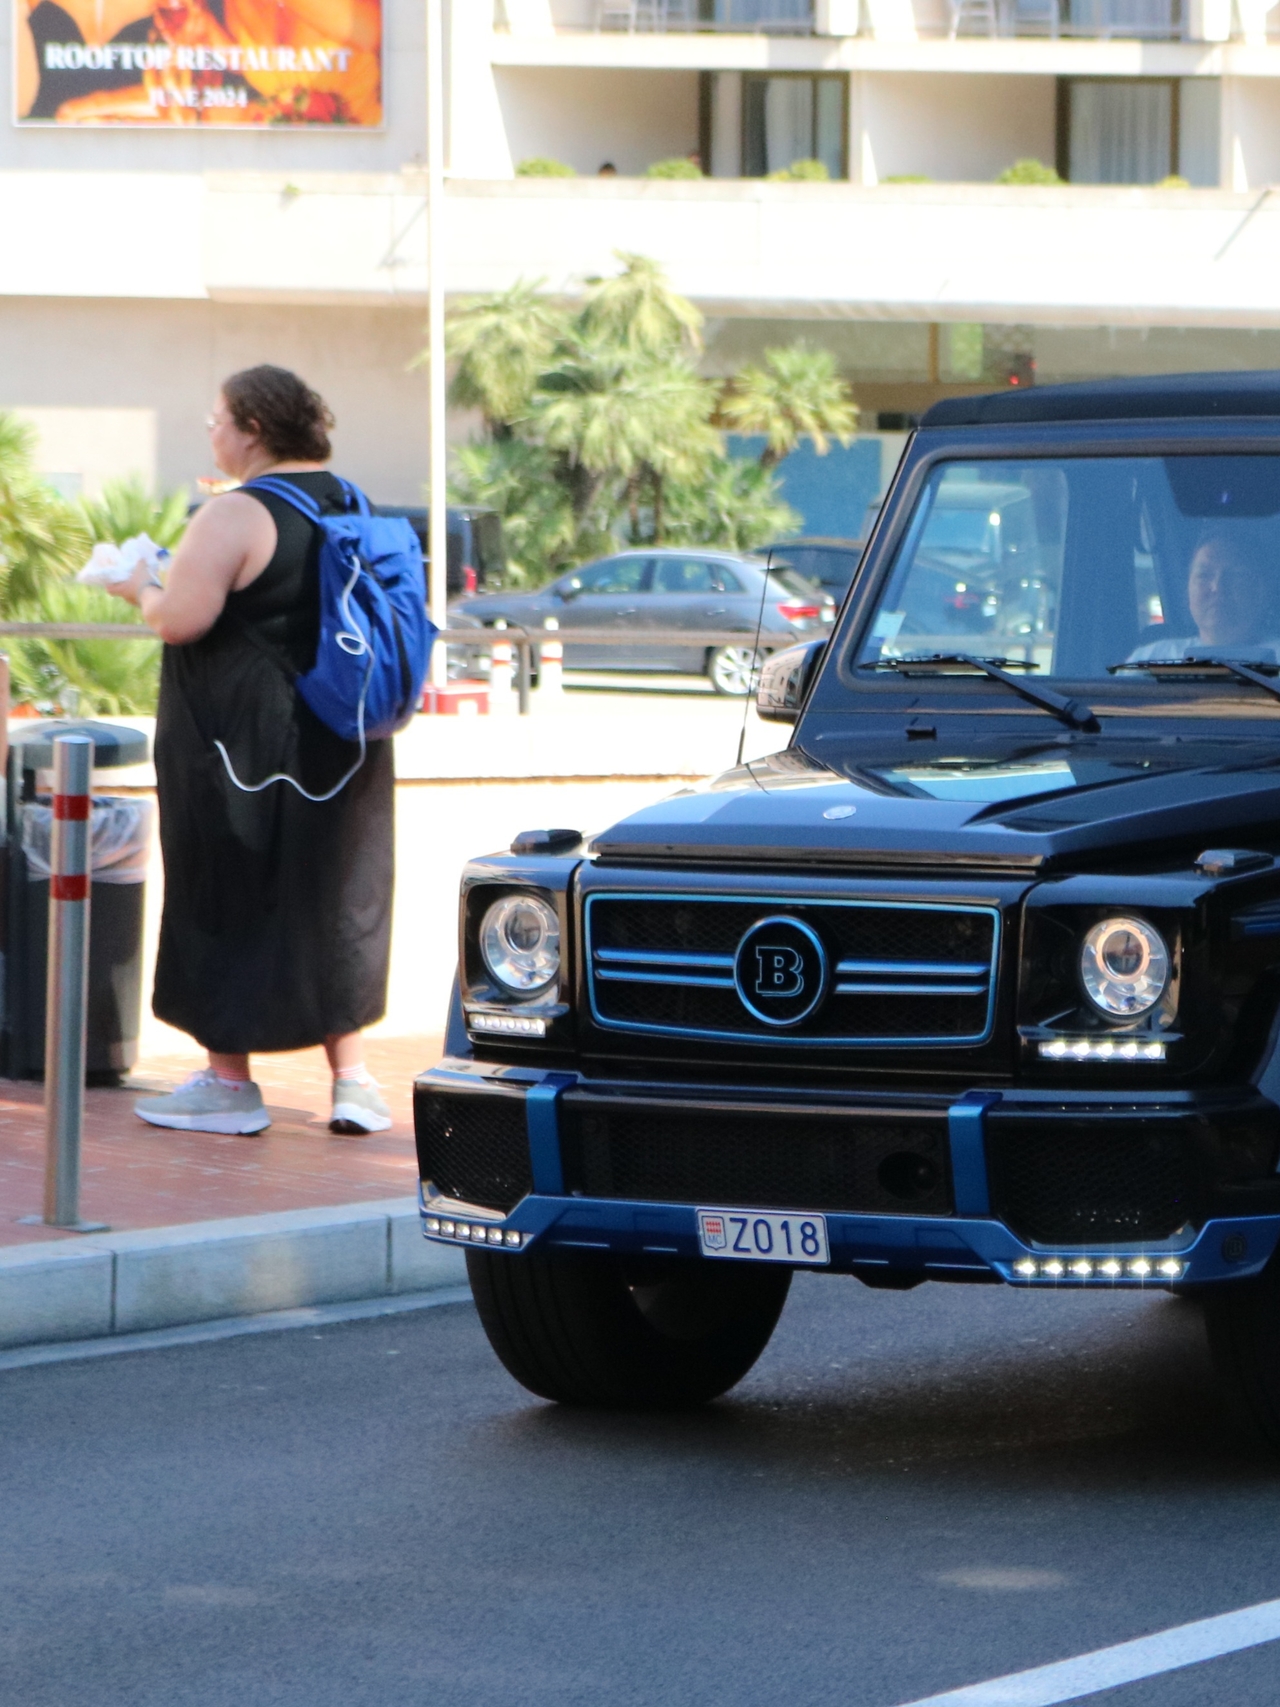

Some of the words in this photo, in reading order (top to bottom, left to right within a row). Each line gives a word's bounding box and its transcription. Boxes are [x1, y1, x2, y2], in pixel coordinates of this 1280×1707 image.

[45, 42, 171, 70] ROOFTOP
[176, 46, 351, 72] RESTAURANT
[150, 87, 199, 108] JUNE
[203, 87, 248, 109] 2024
[755, 946, 804, 997] B
[729, 1217, 820, 1256] Z018
